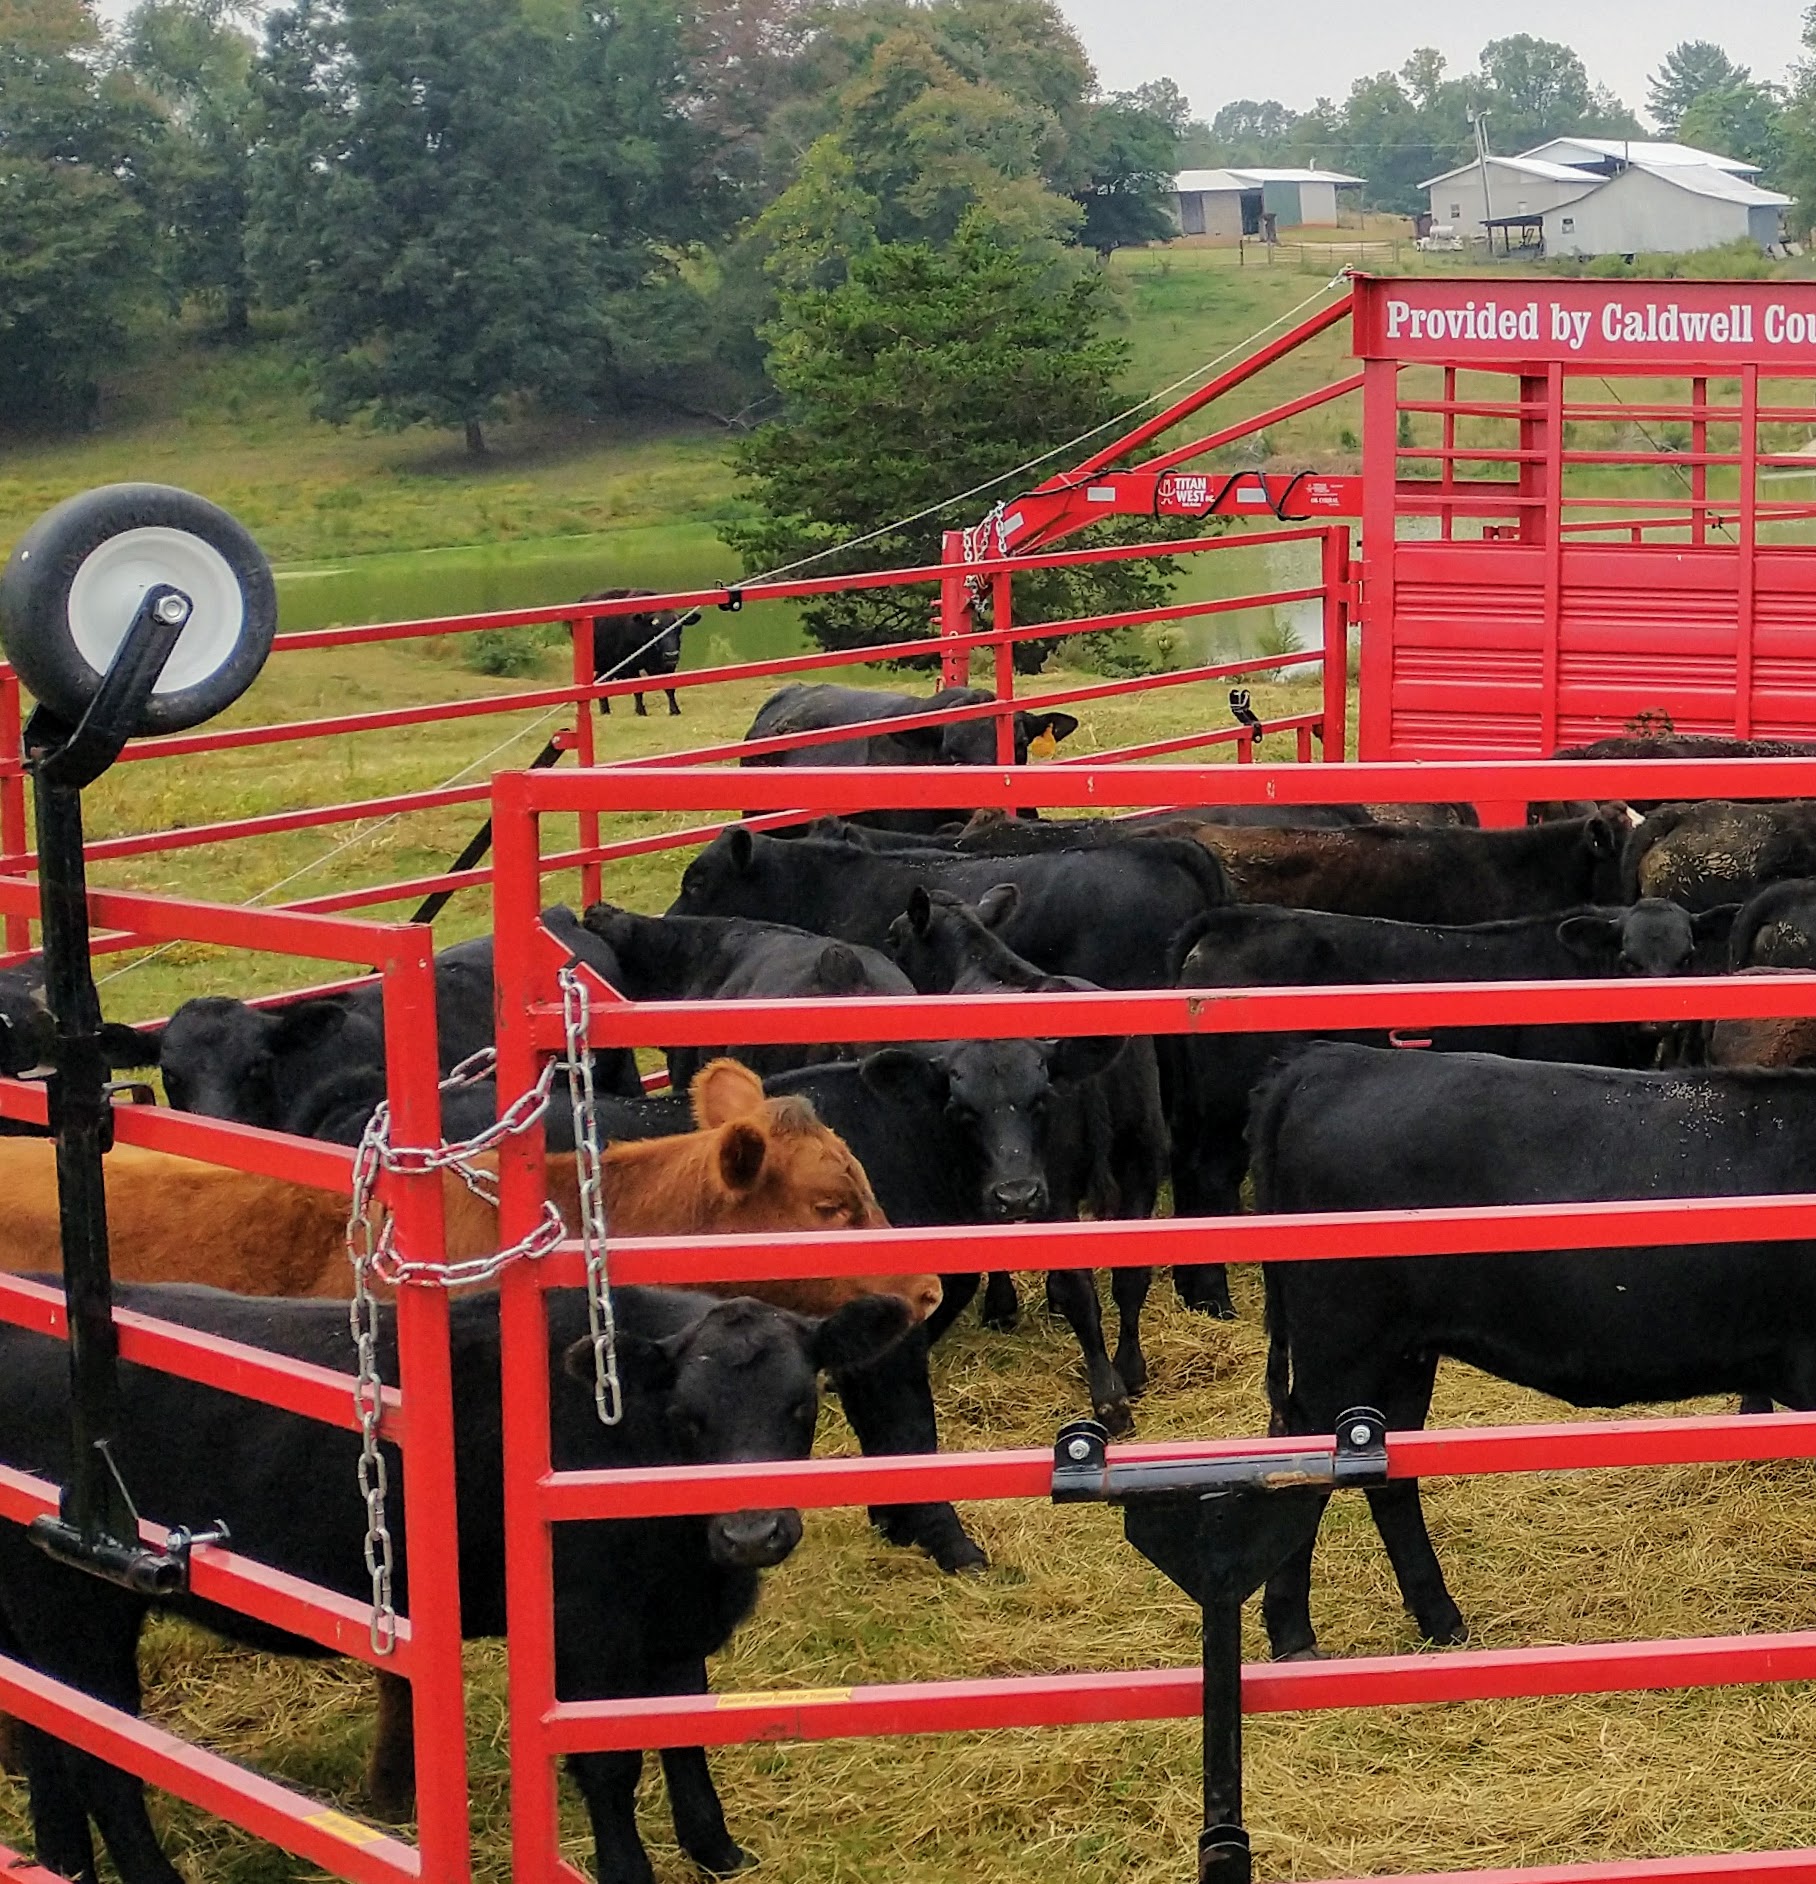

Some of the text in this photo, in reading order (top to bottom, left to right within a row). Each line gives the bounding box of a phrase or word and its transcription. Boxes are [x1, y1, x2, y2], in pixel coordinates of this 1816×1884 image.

[1386, 301, 1540, 341] Provided
[1550, 303, 1592, 350] by
[1602, 302, 1754, 343] Caldwell
[1174, 477, 1207, 490] TITAN
[1176, 490, 1206, 503] WEST
